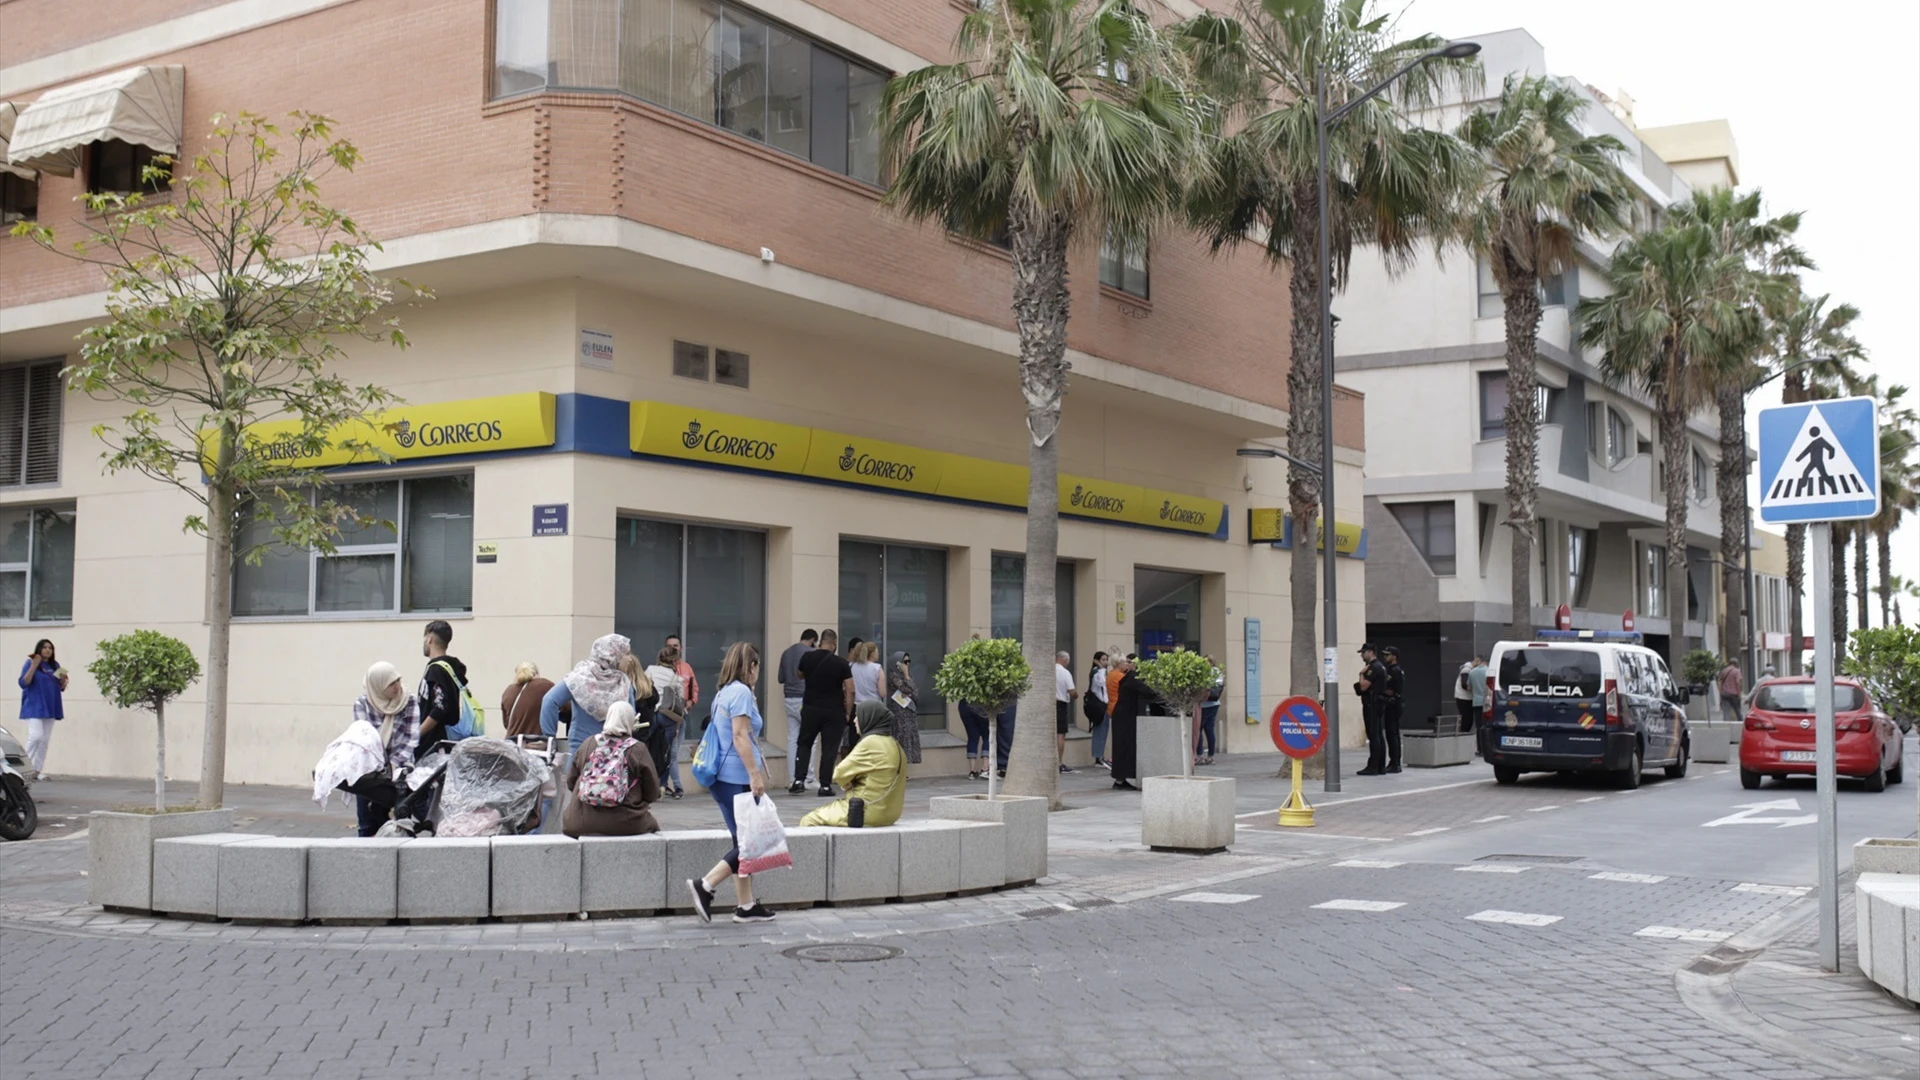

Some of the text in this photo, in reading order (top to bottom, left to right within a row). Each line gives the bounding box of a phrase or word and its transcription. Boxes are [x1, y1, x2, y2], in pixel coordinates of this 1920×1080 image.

[592, 343, 613, 354] EULEN
[419, 420, 502, 447] CORREOS
[704, 429, 777, 461] CORREOS
[856, 453, 916, 482] CORREOS
[1082, 491, 1126, 513] CORREOS
[1169, 505, 1207, 526] CORREOS
[1508, 685, 1583, 697] POLICIA
